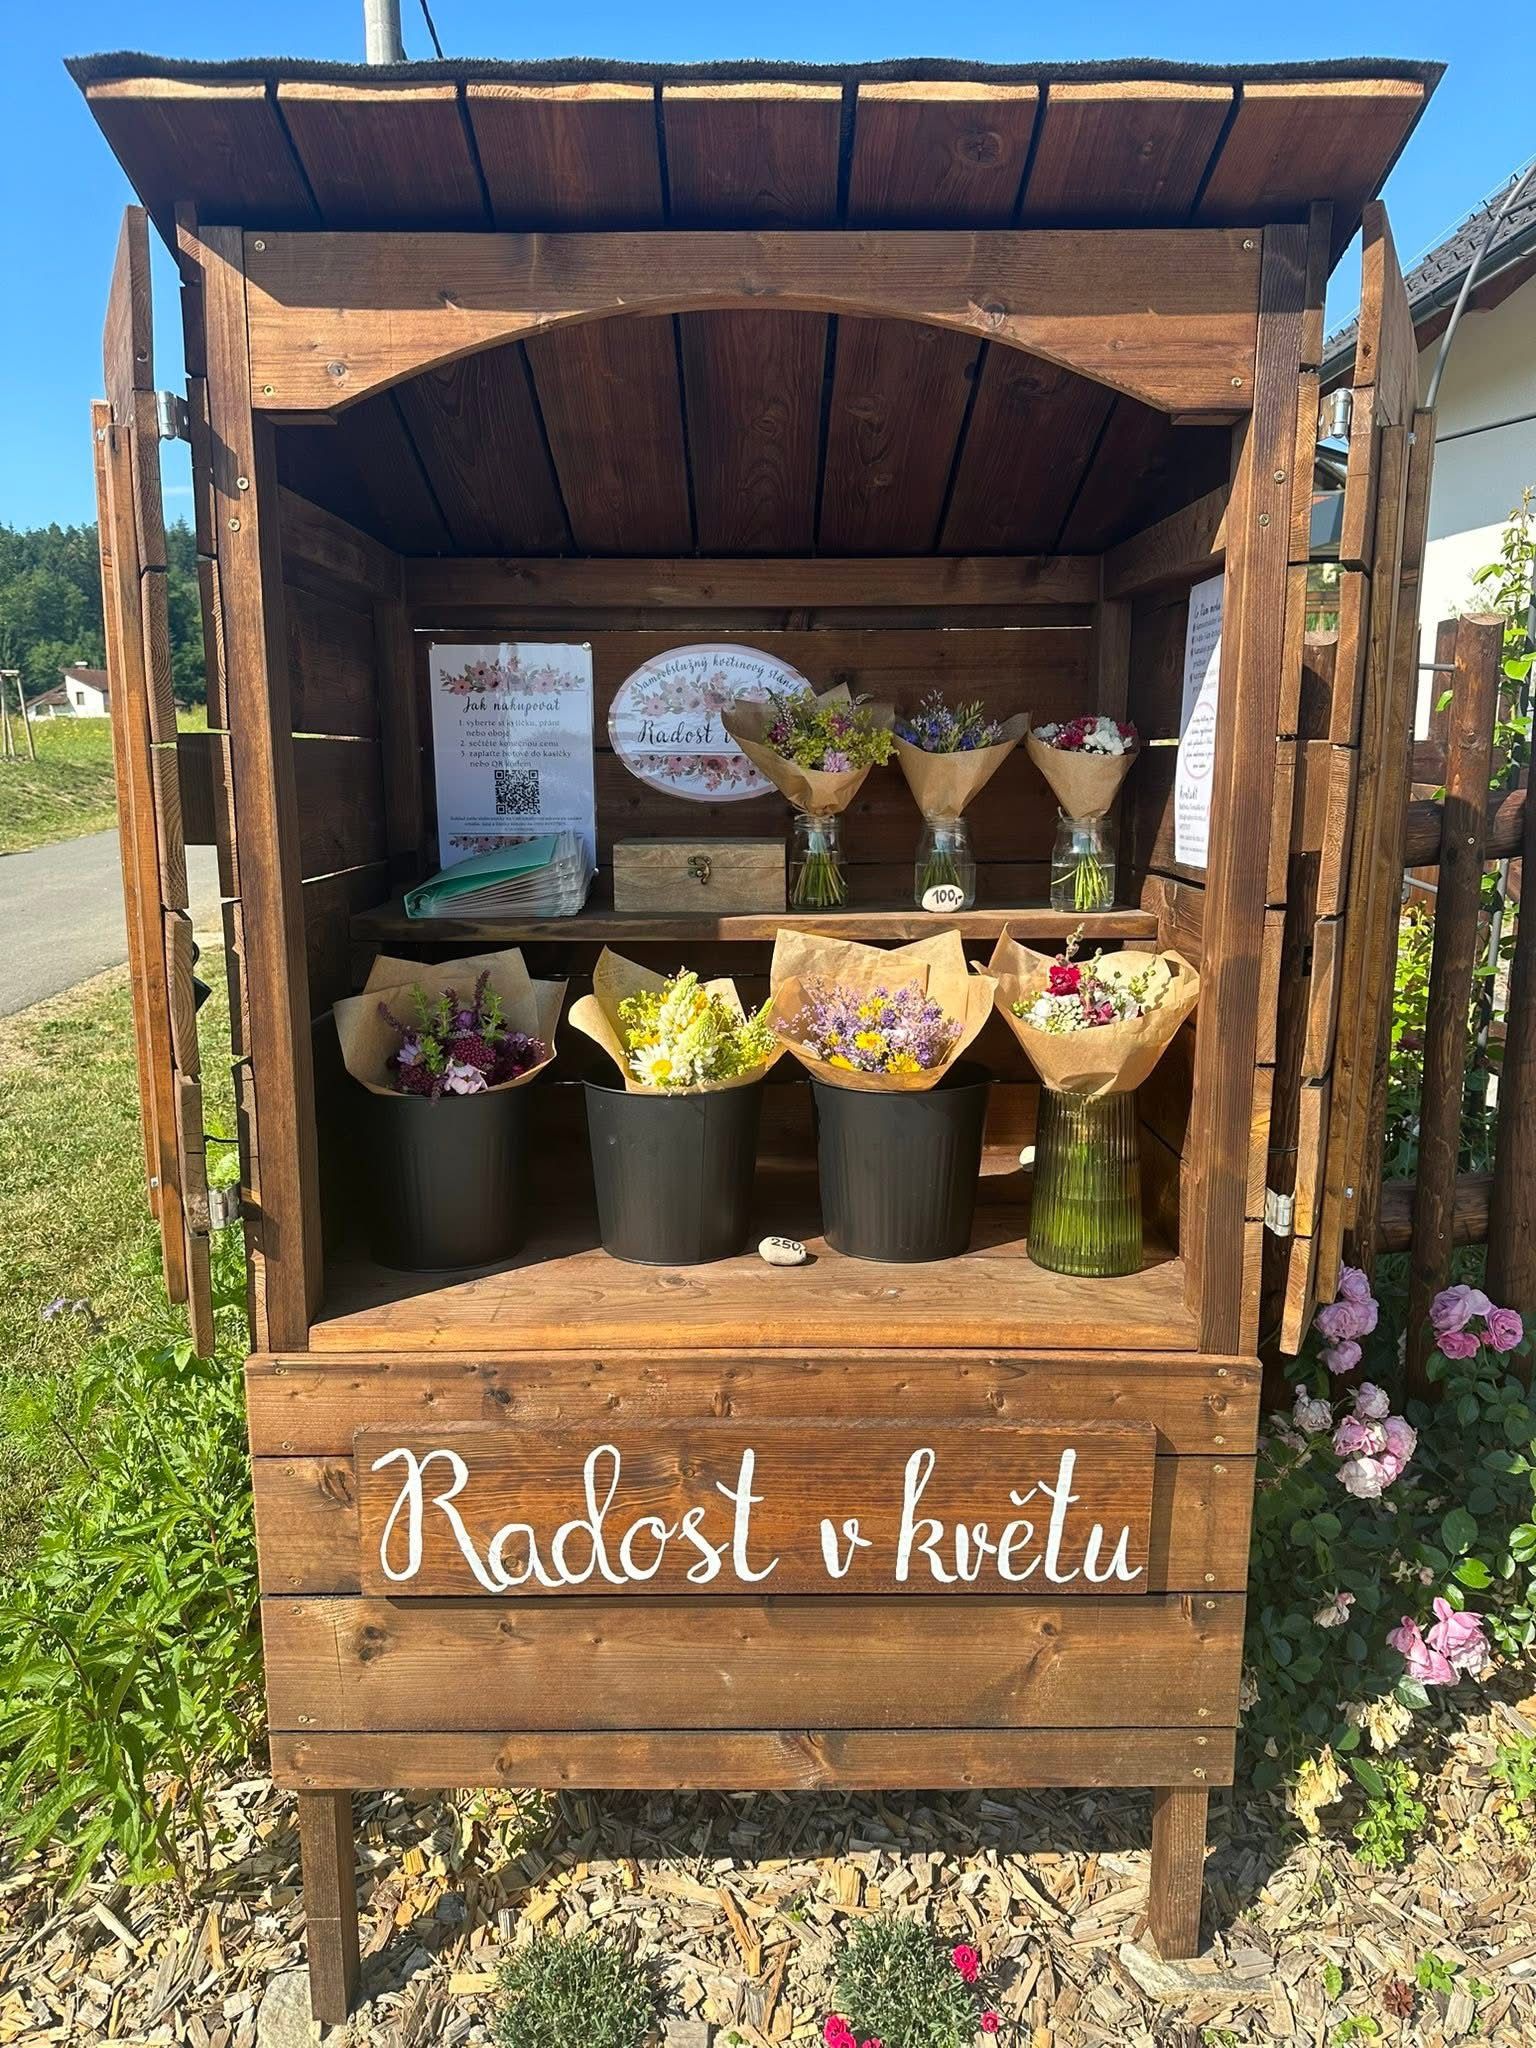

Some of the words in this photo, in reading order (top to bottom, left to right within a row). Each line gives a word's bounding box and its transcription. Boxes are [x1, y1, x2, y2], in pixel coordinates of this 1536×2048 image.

[463, 696, 487, 713] Jak
[494, 696, 560, 717] nakupovat
[466, 719, 496, 728] vyberte
[466, 729, 485, 737] nebo
[637, 719, 713, 745] Radost
[530, 750, 541, 758] do
[470, 759, 490, 768] nebo
[491, 760, 503, 768] QR
[932, 889, 963, 905] 100,-
[371, 1444, 780, 1592] Radost
[820, 1518, 872, 1579] v
[895, 1447, 1143, 1583] květu
